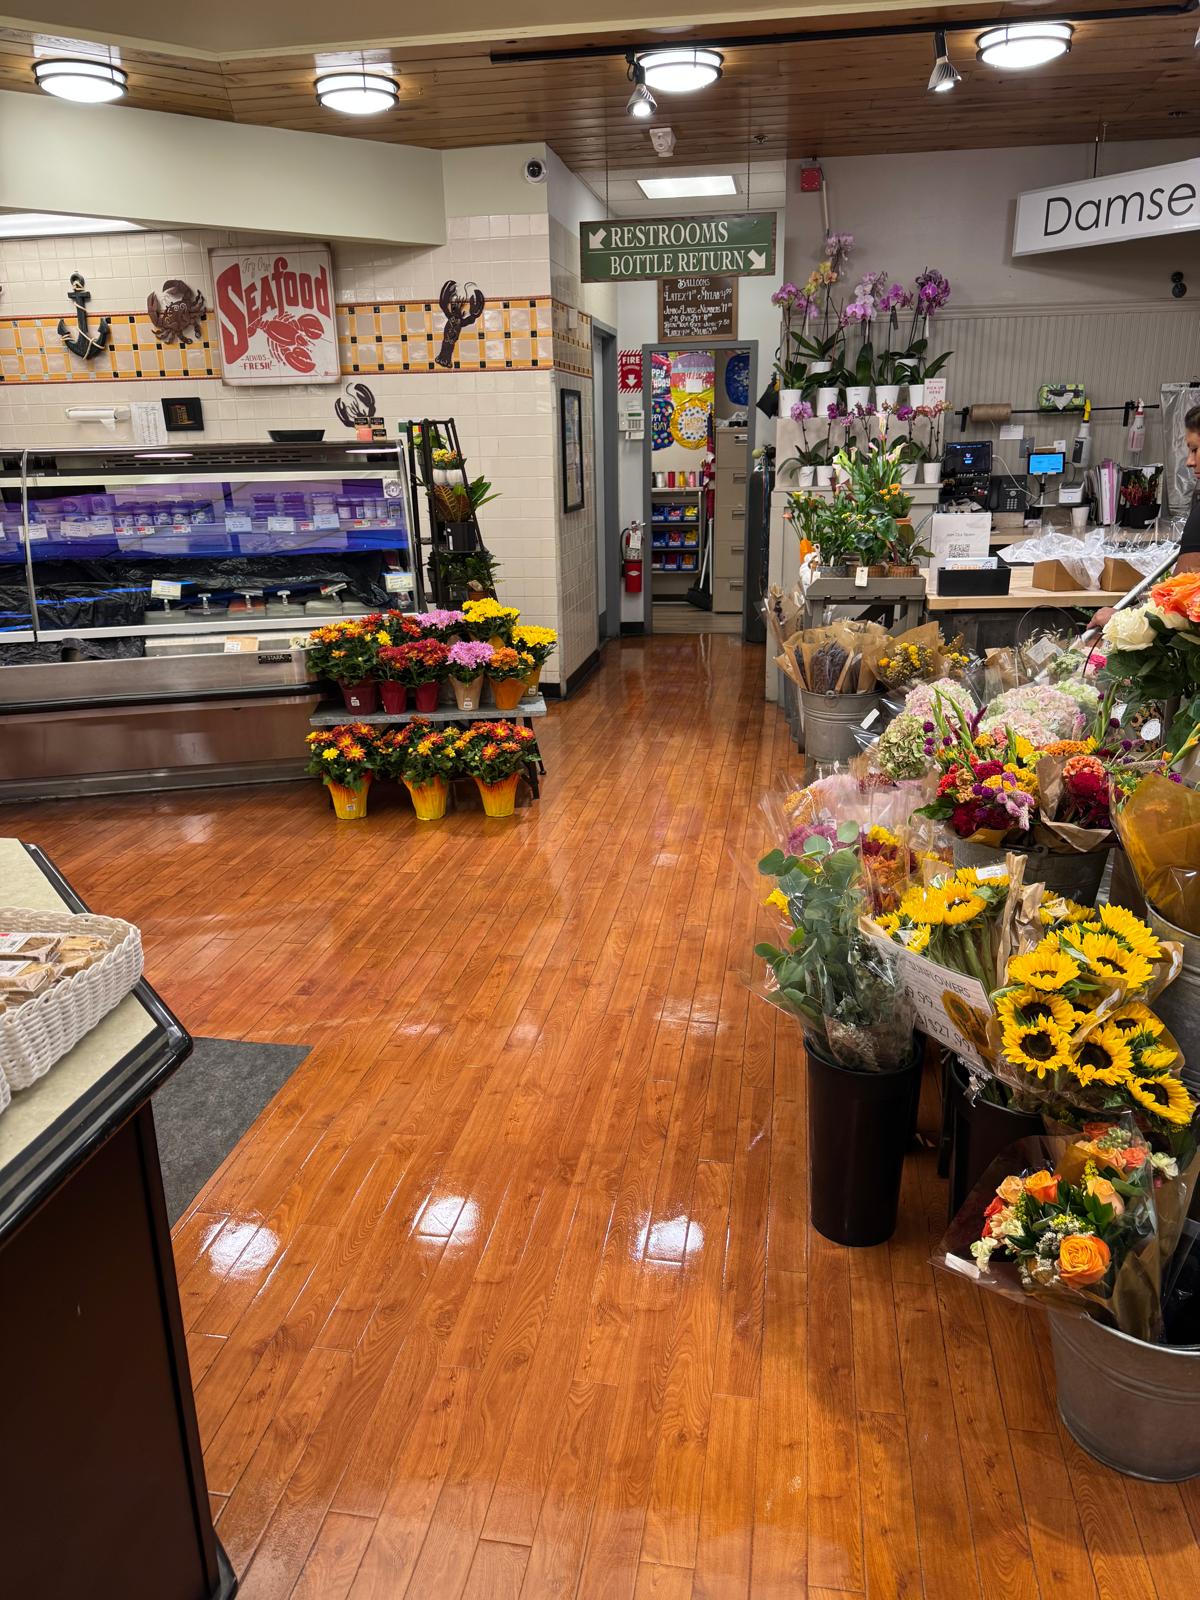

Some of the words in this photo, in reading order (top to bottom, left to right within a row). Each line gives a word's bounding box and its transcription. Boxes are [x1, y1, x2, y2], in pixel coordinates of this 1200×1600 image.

[1044, 183, 1196, 236] Damse
[610, 221, 729, 248] RESTROOMS
[610, 252, 674, 276] BOTTLE
[677, 250, 746, 273] RETURN
[622, 356, 641, 364] FIRE
